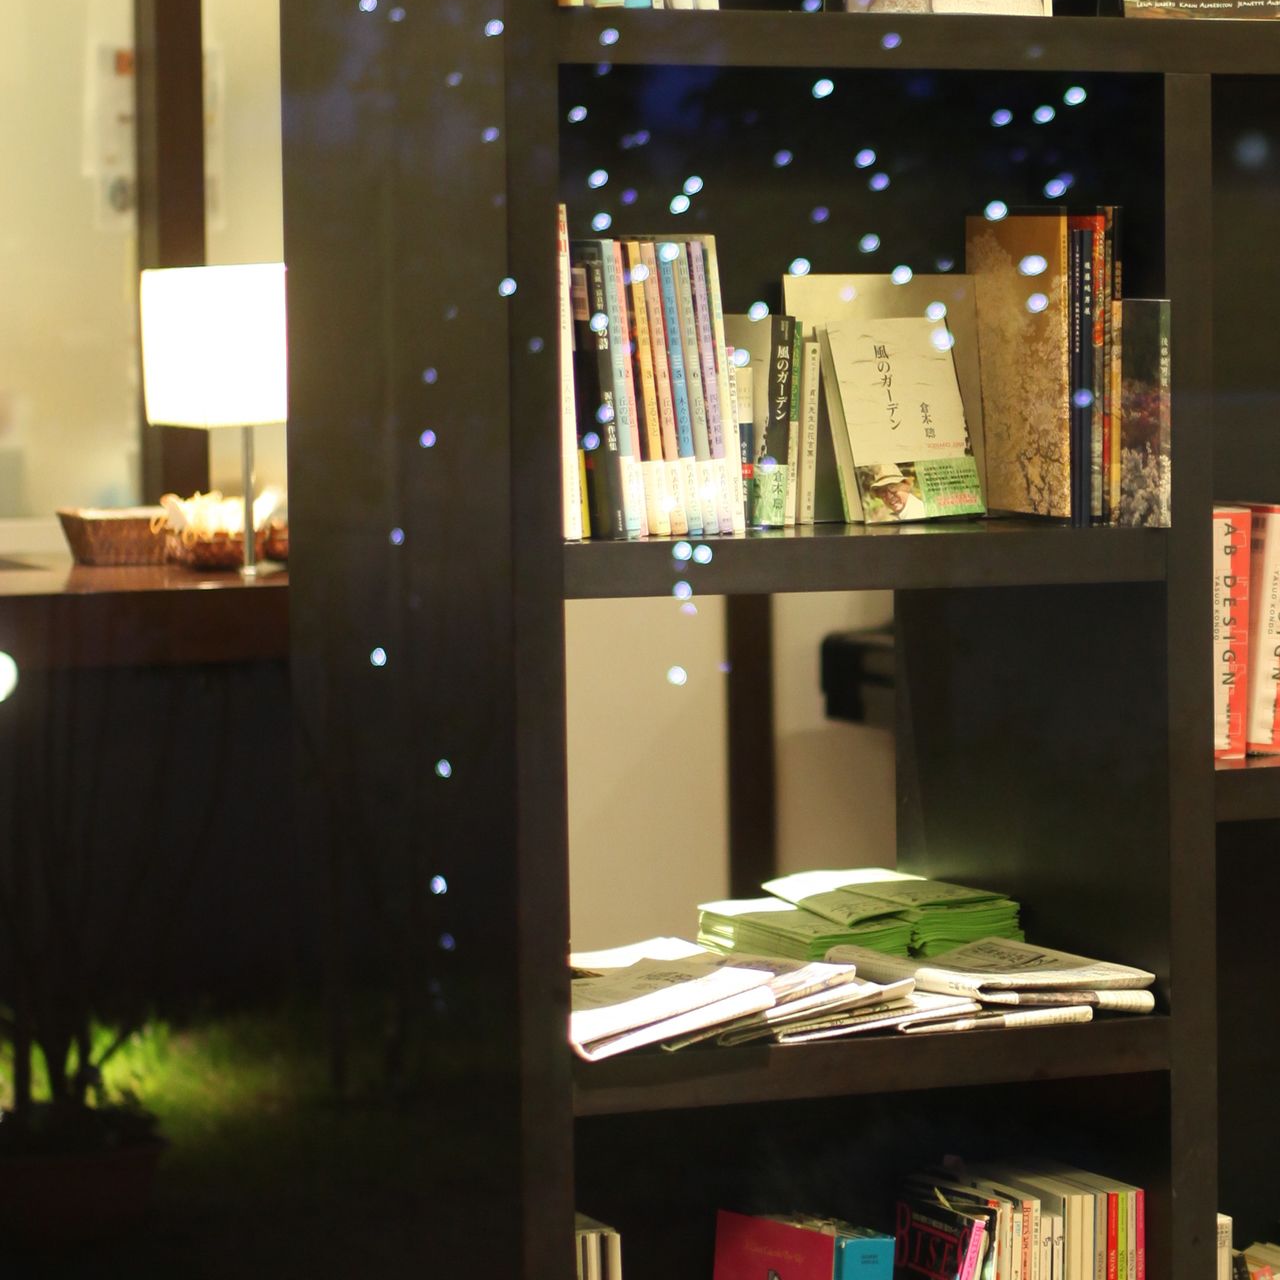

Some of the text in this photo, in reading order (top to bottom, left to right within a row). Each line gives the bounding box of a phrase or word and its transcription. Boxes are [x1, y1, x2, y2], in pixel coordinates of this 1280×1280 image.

[775, 345, 790, 421] 風のガーデン
[873, 344, 903, 431] 風のガーデン
[1222, 574, 1238, 687] DESIGN
